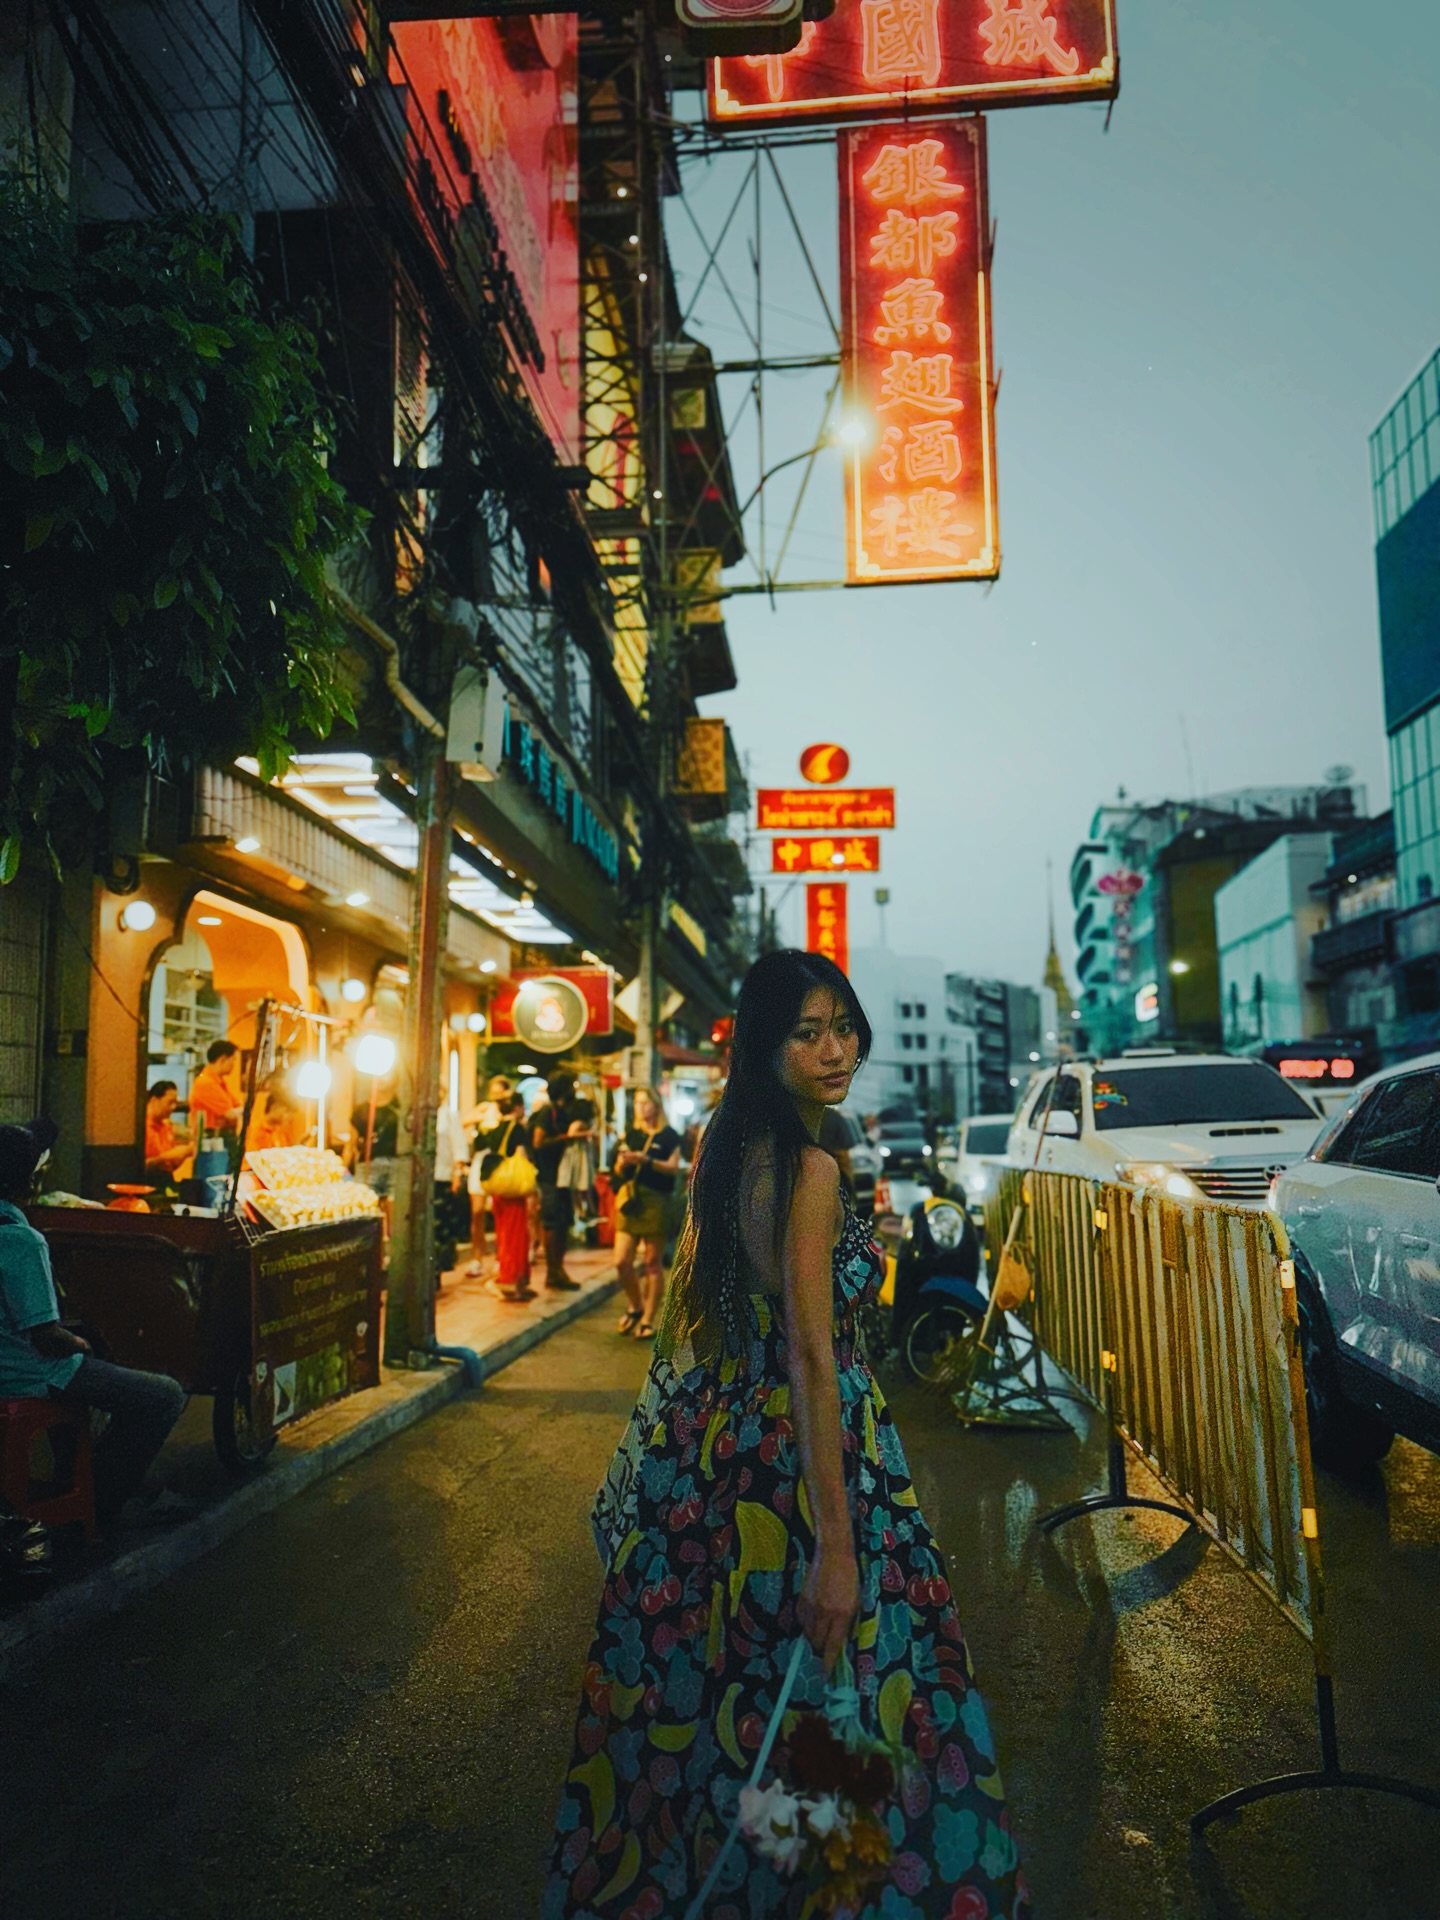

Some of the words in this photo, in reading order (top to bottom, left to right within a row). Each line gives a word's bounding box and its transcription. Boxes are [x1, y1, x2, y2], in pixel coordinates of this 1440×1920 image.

[862, 138, 974, 558] 銀都魚翅酒樓
